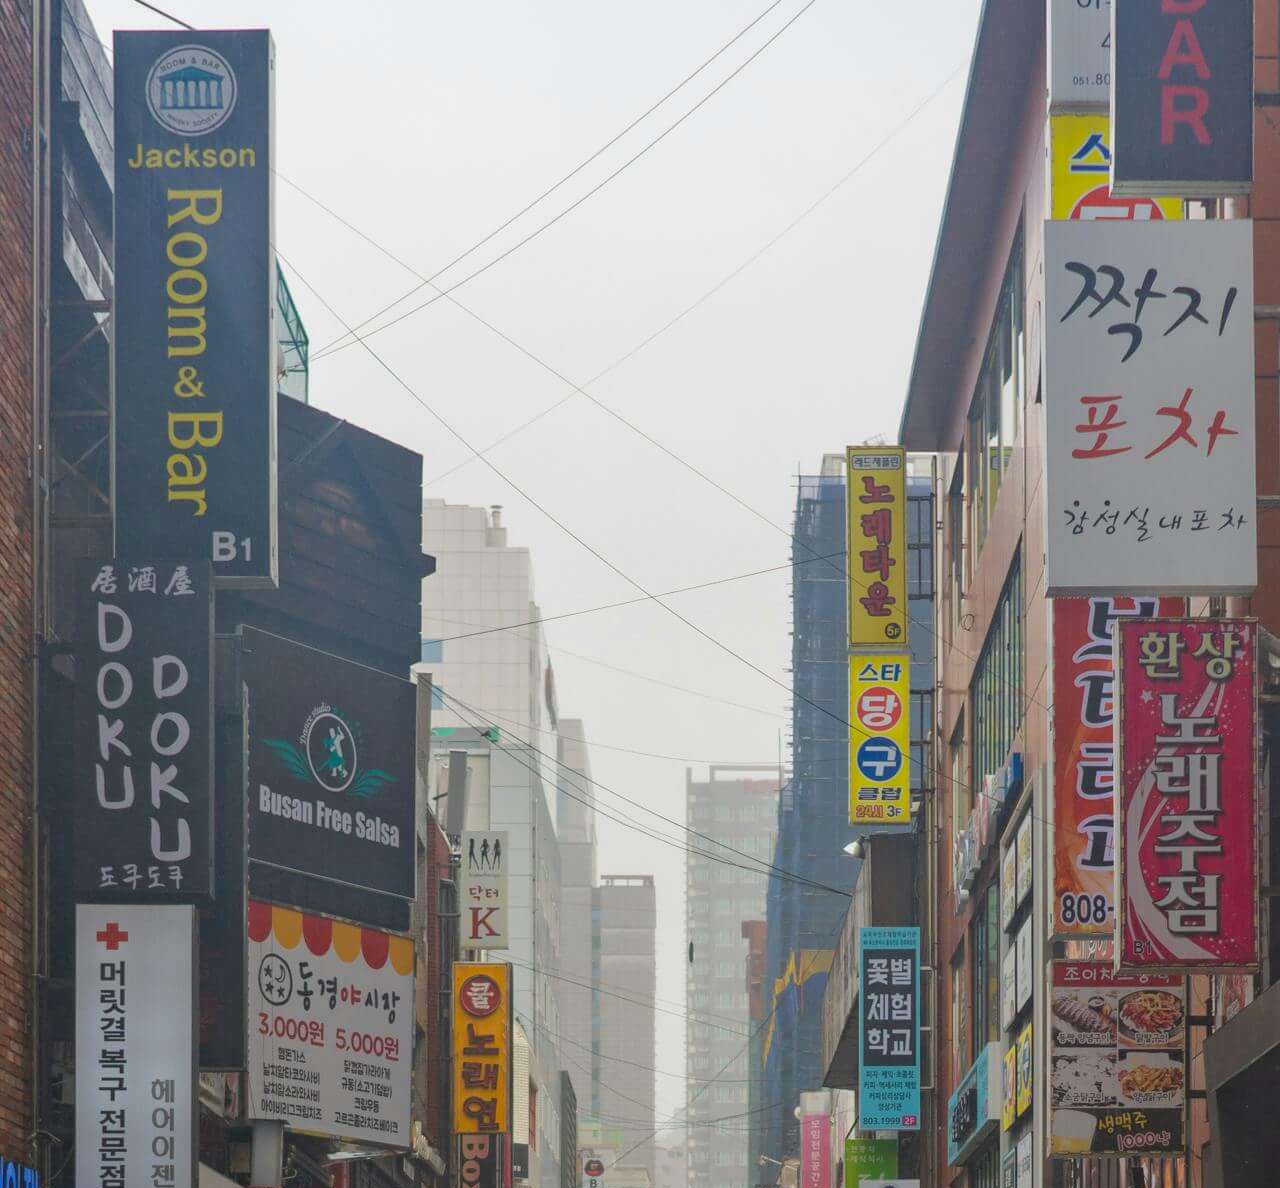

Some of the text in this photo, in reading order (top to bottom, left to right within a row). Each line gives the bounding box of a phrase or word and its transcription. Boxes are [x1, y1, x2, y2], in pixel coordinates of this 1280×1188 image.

[1158, 0, 1212, 145] AR
[128, 144, 256, 169] Jackson
[1060, 260, 1238, 363] 짝지
[166, 188, 223, 517] Room & Bar
[1071, 388, 1239, 460] 포차
[212, 531, 253, 562] B1
[858, 475, 898, 617] 노래타운
[90, 564, 197, 595] 居酒屋
[857, 662, 903, 684] 스타
[95, 602, 136, 811] DOKU
[859, 691, 902, 781] 당구
[151, 655, 192, 862] DOKU
[856, 785, 903, 801] 클럽
[259, 784, 400, 848] Busan Free Salsa
[886, 805, 902, 819] 3F
[1153, 693, 1224, 935] 노래주점
[99, 866, 185, 890] 도쿠도쿠
[468, 885, 500, 901] 닥터
[469, 906, 502, 940] K
[1132, 939, 1153, 955] B1
[867, 958, 913, 986] 꽃별
[867, 993, 913, 1021] 체험
[259, 1012, 399, 1062] 3,000원 5,000원
[867, 1027, 913, 1057] 학교
[150, 1078, 176, 1188] 헤어이젠
